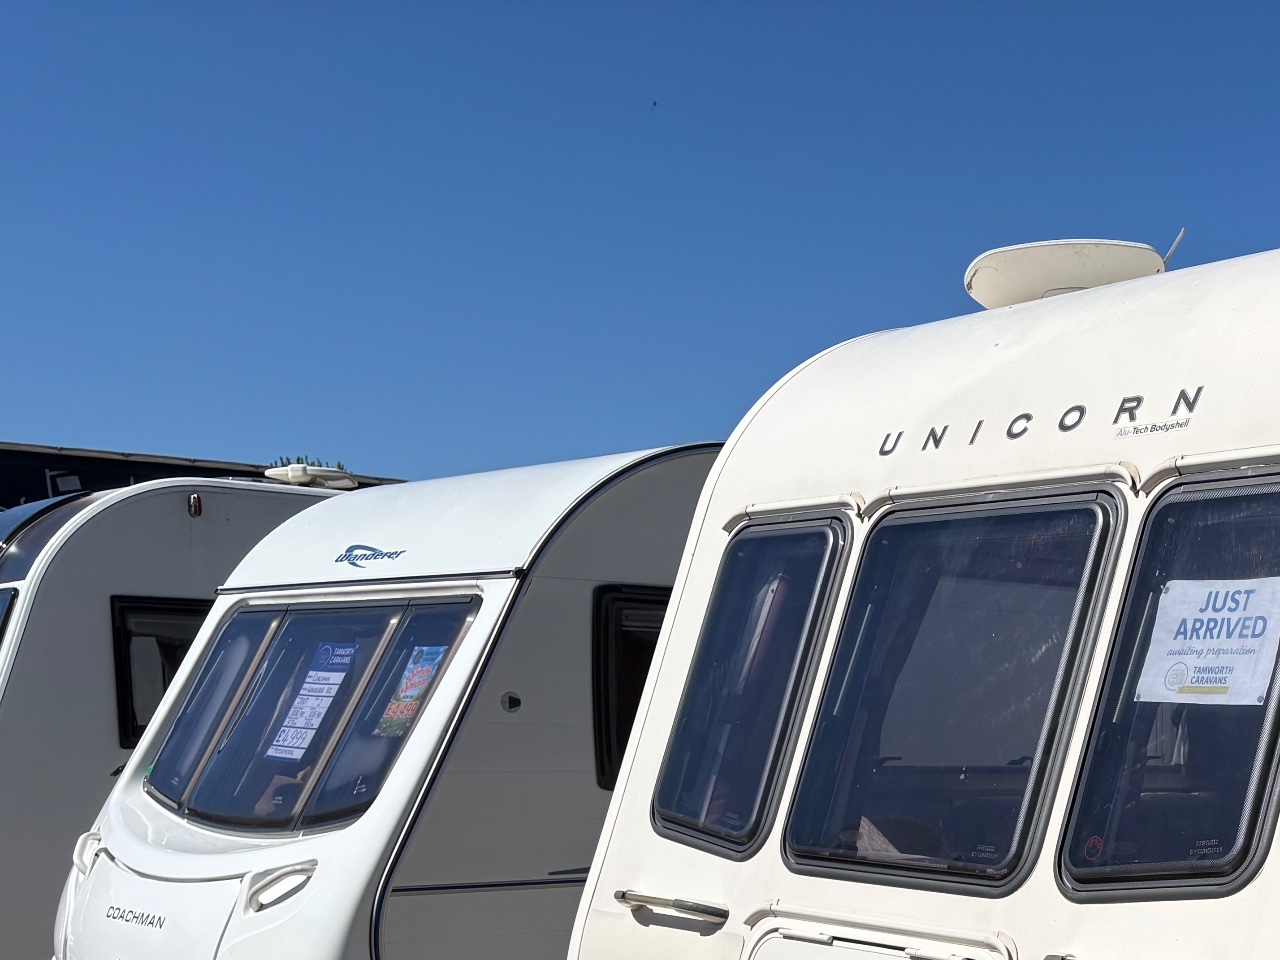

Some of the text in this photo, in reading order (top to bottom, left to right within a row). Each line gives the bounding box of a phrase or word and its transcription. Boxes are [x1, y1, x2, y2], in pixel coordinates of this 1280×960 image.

[879, 386, 1204, 456] UNICORN
[1116, 419, 1190, 438] Alu-Tech Bodyshell
[335, 549, 407, 563] Wanderer
[1199, 589, 1256, 613] JUST
[1173, 615, 1268, 641] ARRIVED
[1166, 645, 1257, 659] awaiting preparation
[1193, 666, 1235, 675] TAMWORTH
[1190, 676, 1228, 685] CARAVANS
[106, 906, 166, 929] COACHMAN
